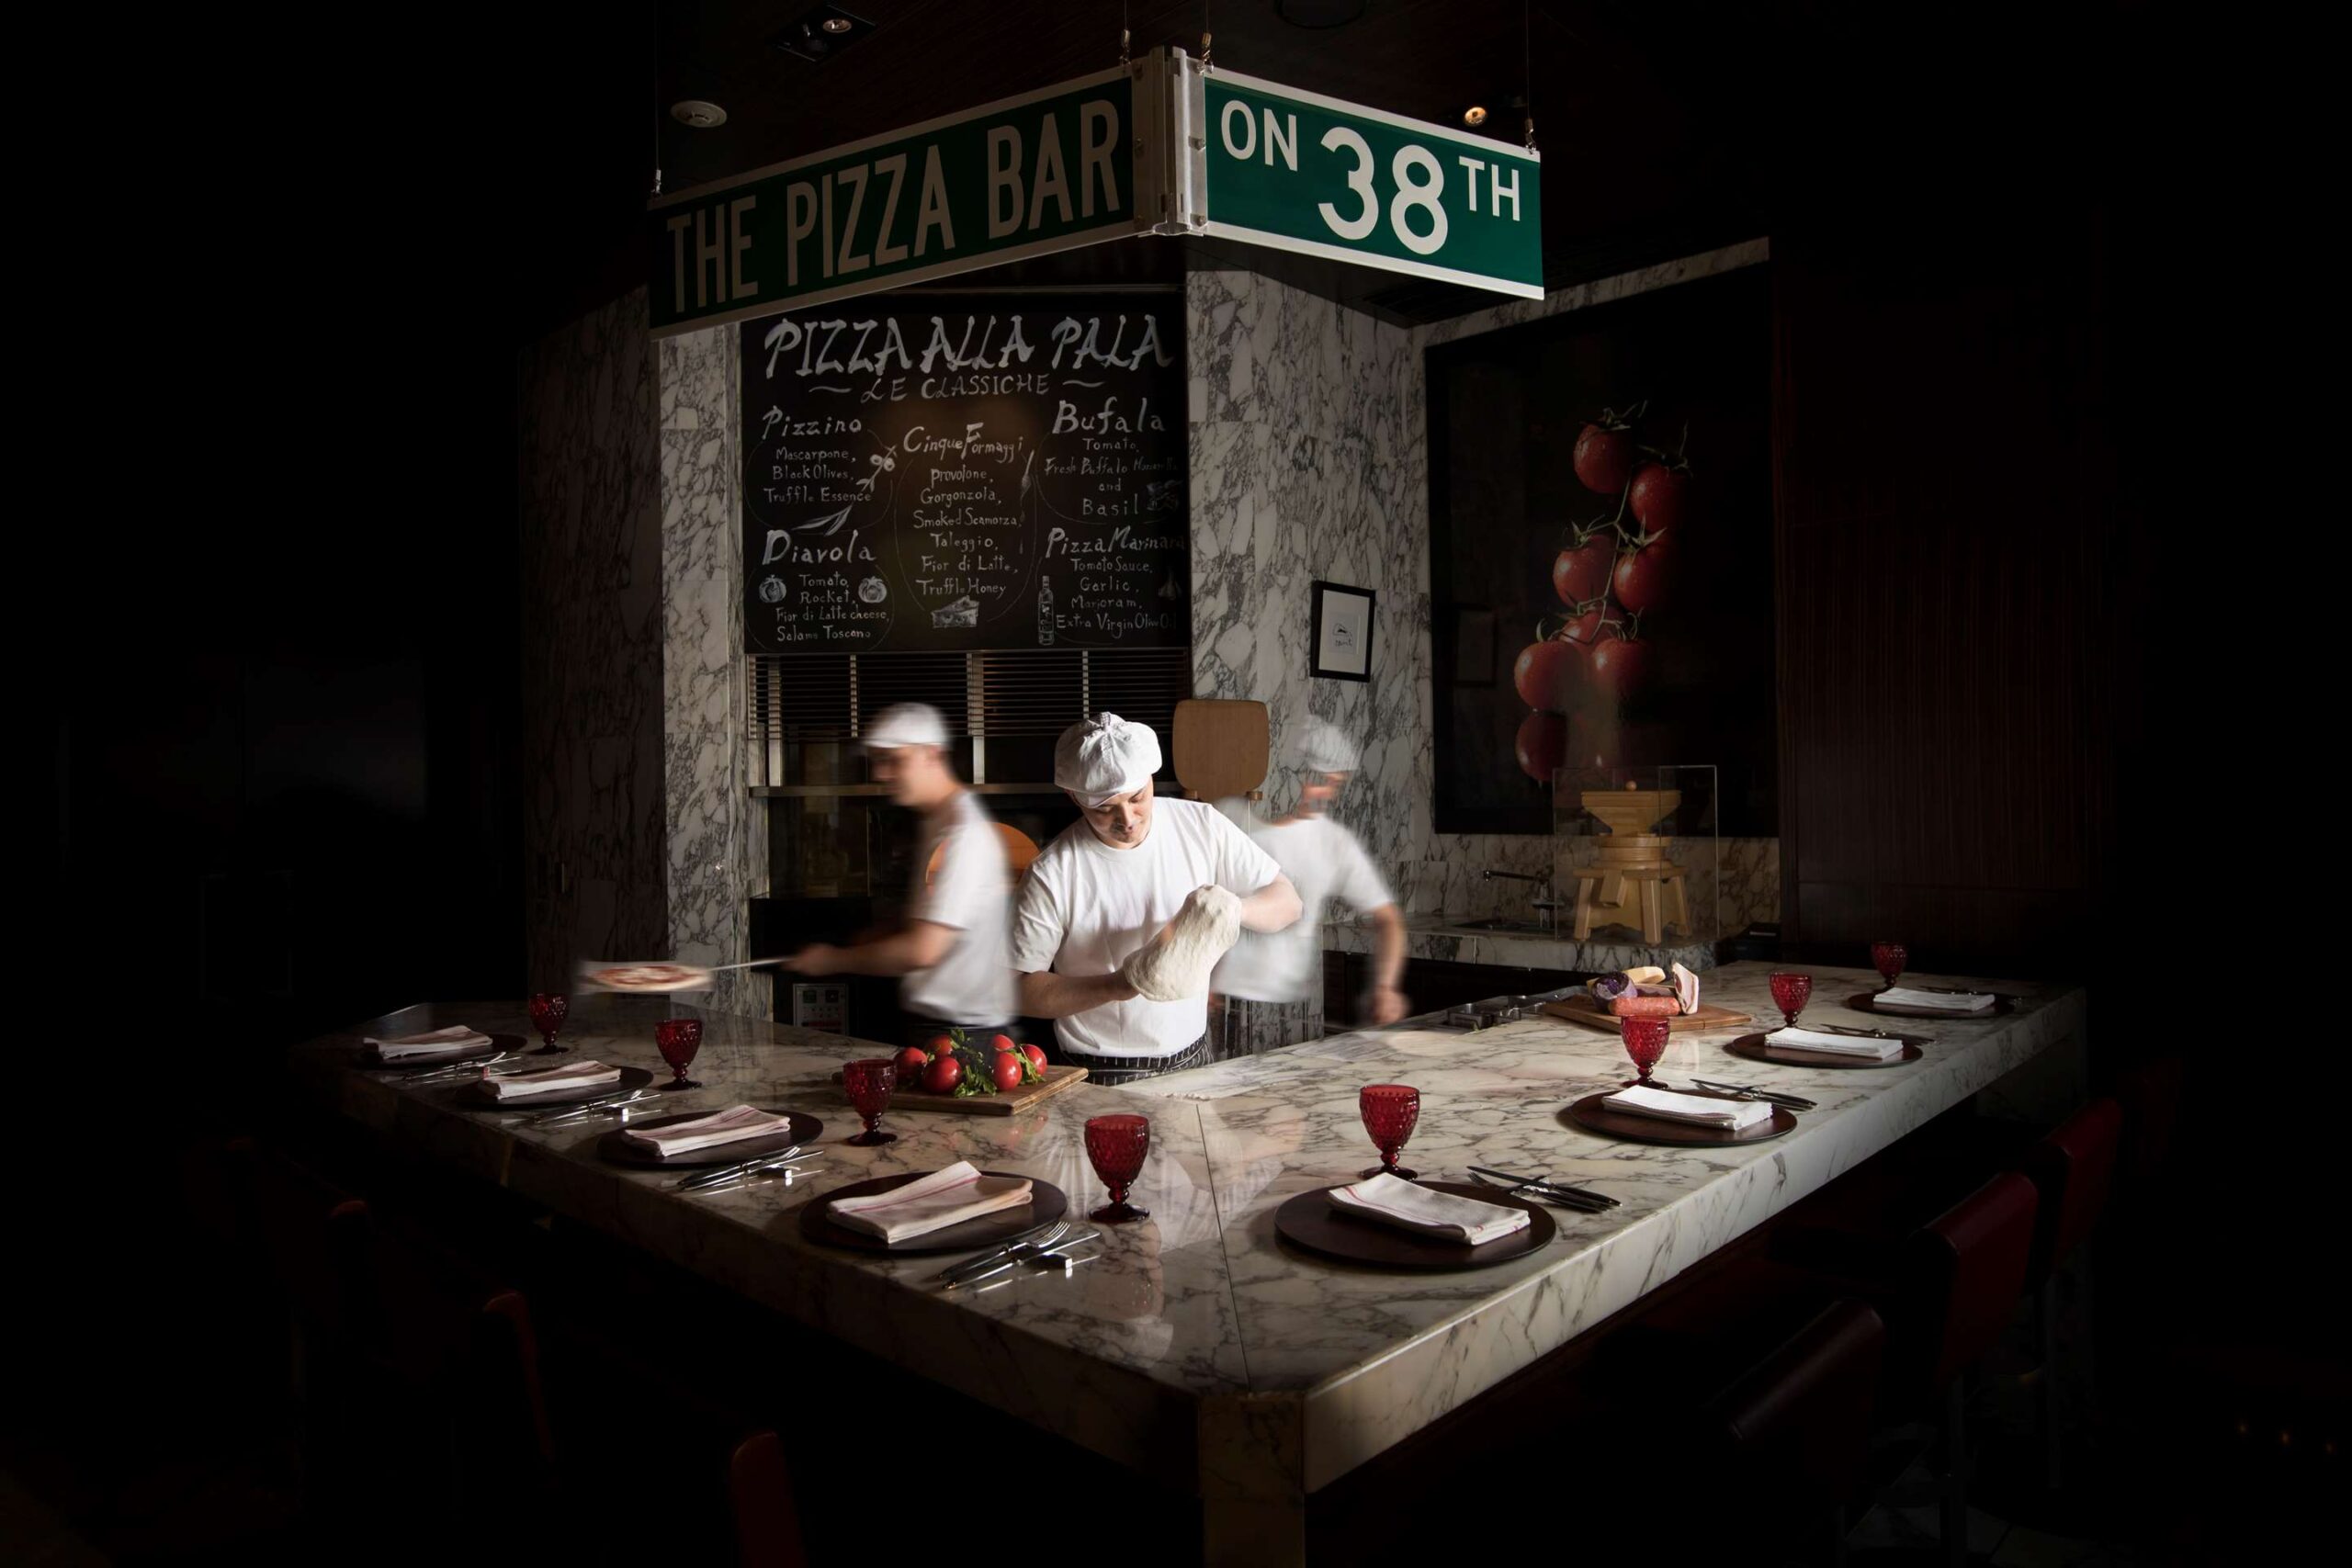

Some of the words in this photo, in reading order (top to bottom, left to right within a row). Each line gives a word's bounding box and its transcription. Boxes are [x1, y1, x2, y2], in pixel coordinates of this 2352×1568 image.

[1220, 99, 1298, 172] ON
[666, 194, 759, 313] THE
[786, 144, 956, 288] PIZZA
[986, 98, 1121, 241] BAR
[763, 316, 913, 380] PIZZA
[919, 314, 1035, 374] ALLA
[1051, 313, 1176, 372] PALA
[860, 377, 908, 404] LE
[921, 373, 1050, 400] CLASSICHE
[762, 405, 862, 441] Pizzino
[1052, 396, 1167, 435] Bufala
[1044, 457, 1076, 476] Fresh
[763, 484, 815, 503] Truffle
[820, 486, 873, 502] Essence
[1082, 492, 1139, 516] Basil
[912, 508, 962, 529] Smoked
[762, 529, 877, 565] Diavola
[921, 555, 949, 573] Fior
[958, 555, 971, 571] di
[1070, 556, 1113, 571] Tomato
[915, 578, 965, 595] Truffle
[967, 578, 1006, 600] Honey
[775, 606, 797, 622] Fior
[802, 605, 813, 621] di
[819, 605, 846, 621] Latte
[822, 624, 871, 640] Toscano
[1057, 614, 1091, 629] Extra
[1096, 613, 1134, 639] Virgin
